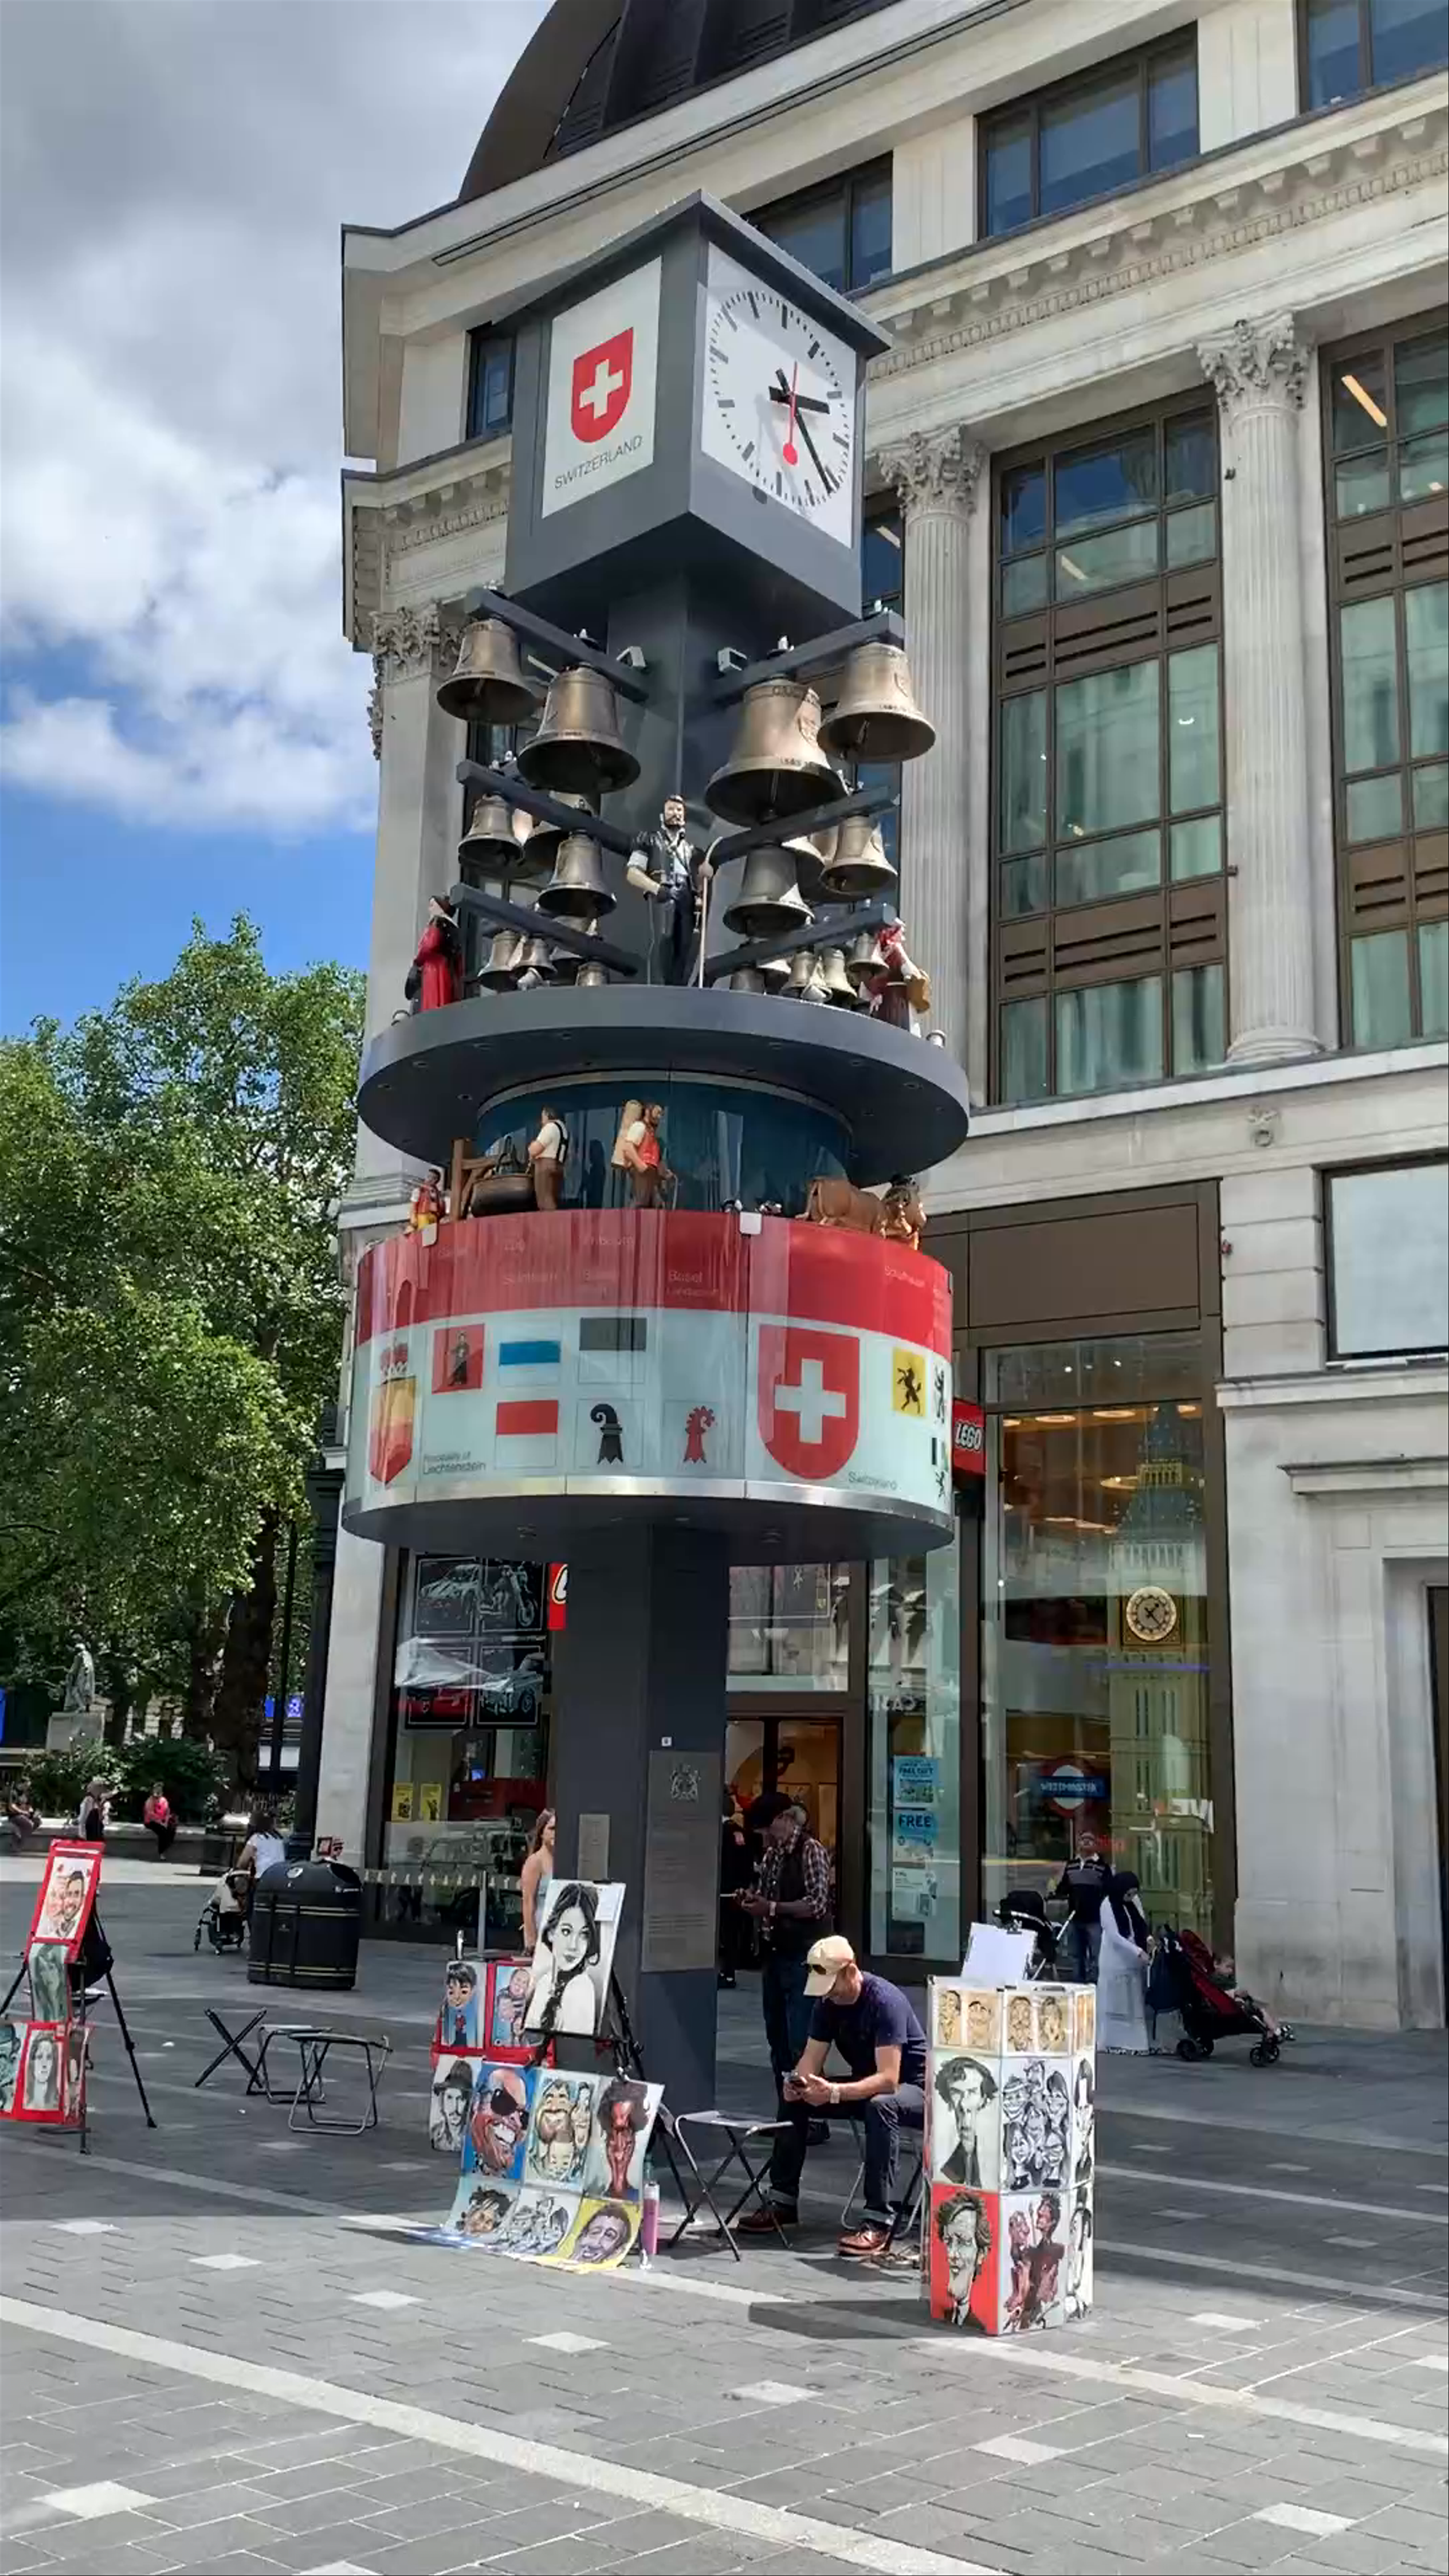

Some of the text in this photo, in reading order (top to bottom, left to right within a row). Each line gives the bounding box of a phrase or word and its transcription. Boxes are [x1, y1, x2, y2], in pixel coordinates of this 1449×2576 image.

[554, 435, 643, 489] SWITZERLAND
[954, 1421, 983, 1452] LEGO
[899, 1814, 931, 1827] FREE
